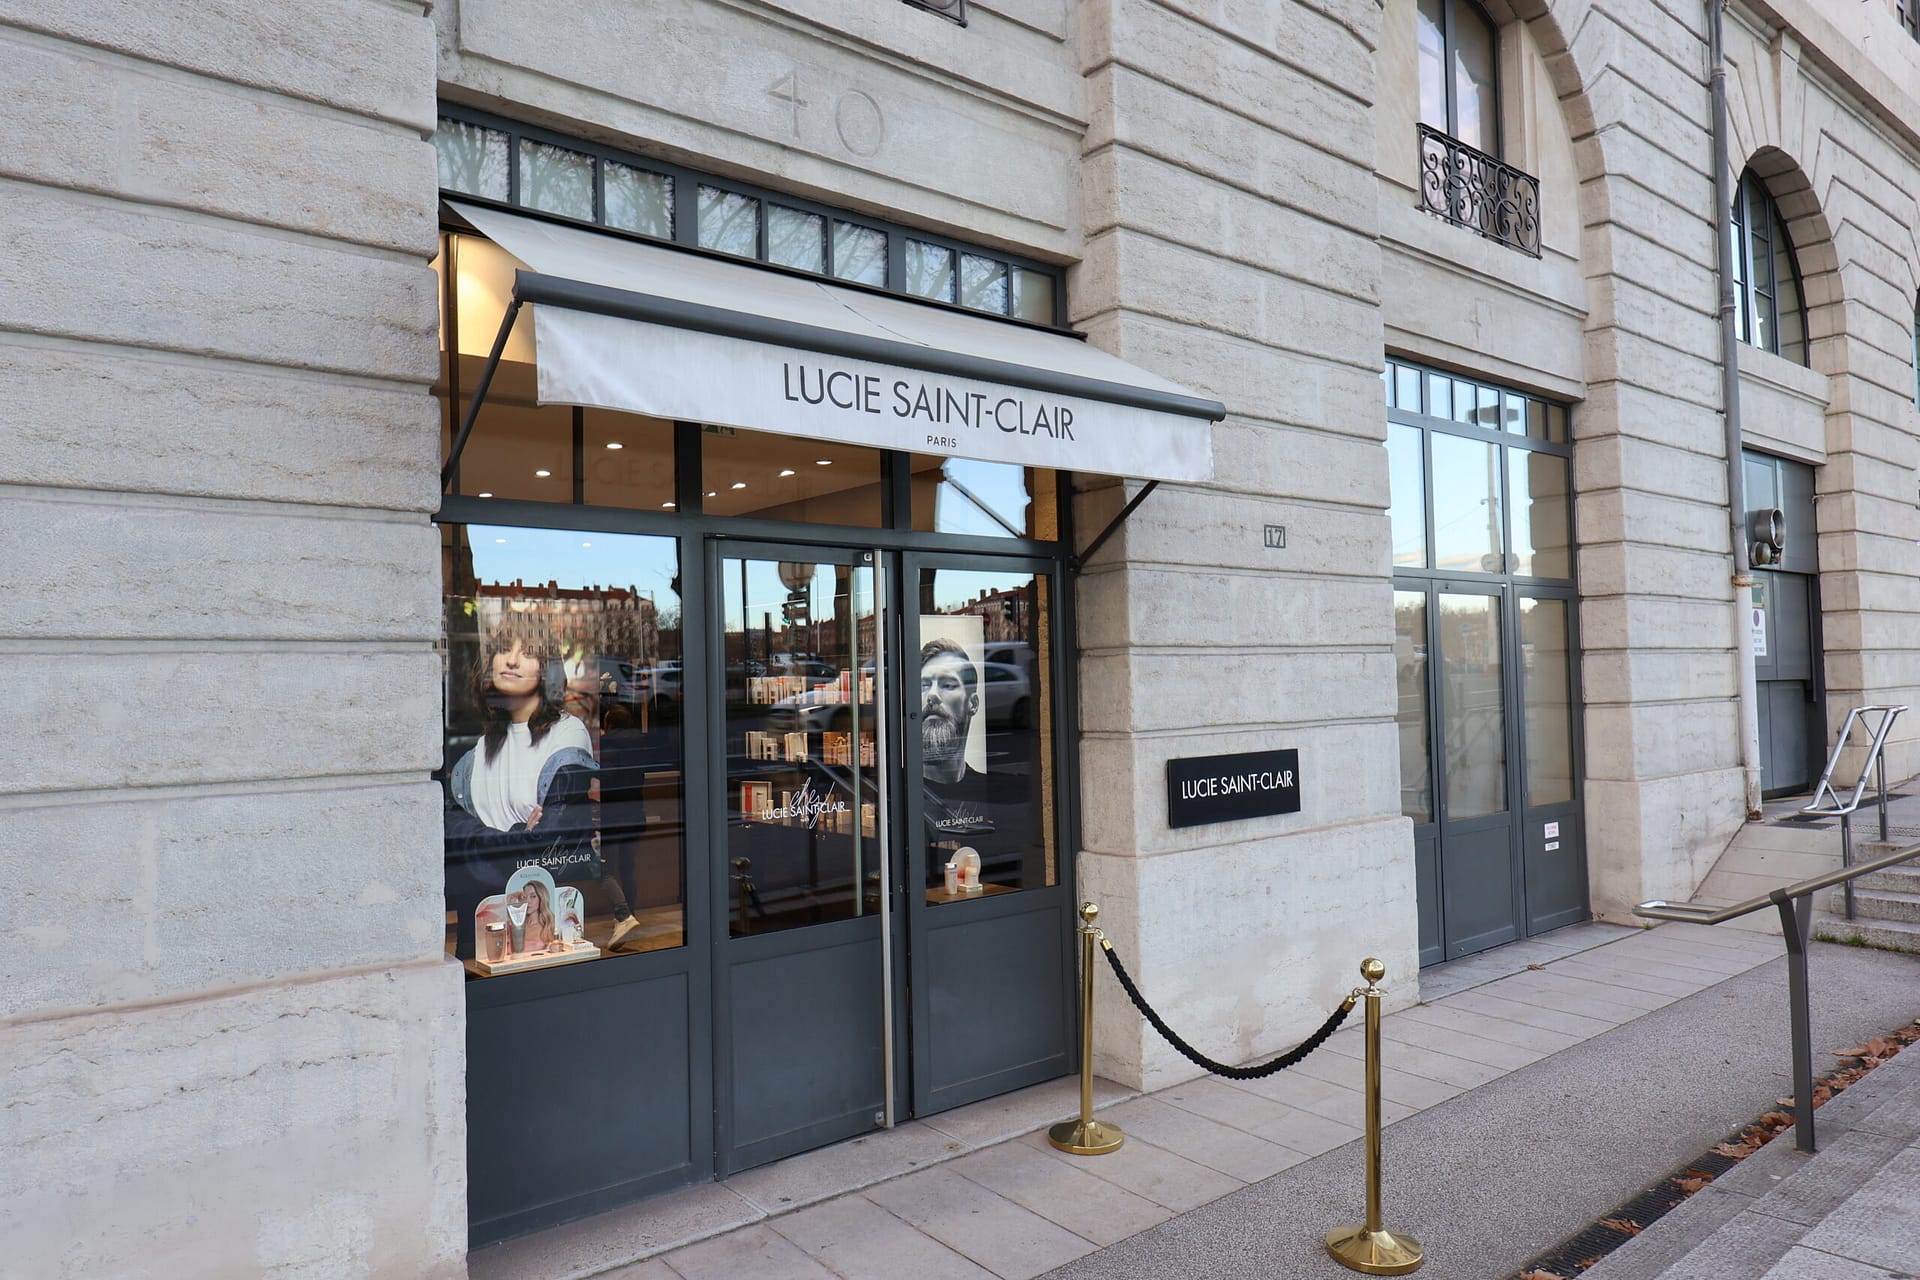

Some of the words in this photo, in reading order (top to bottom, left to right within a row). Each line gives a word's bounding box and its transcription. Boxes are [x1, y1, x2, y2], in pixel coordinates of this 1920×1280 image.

[767, 72, 885, 158] 40
[783, 362, 881, 414] LUCIE
[892, 380, 1076, 441] SAINT-CLAIR
[926, 434, 957, 448] PARIS
[1267, 528, 1282, 546] 17
[1182, 777, 1218, 799] LUCIE
[1221, 770, 1293, 795] SAINT-CLAIR
[762, 807, 788, 820] LUCIE
[790, 801, 845, 817] SAINT-CLAIR
[935, 819, 951, 828] LUCIE
[516, 858, 540, 869] LUCIE
[541, 853, 591, 866] SAINT-CLAIR
